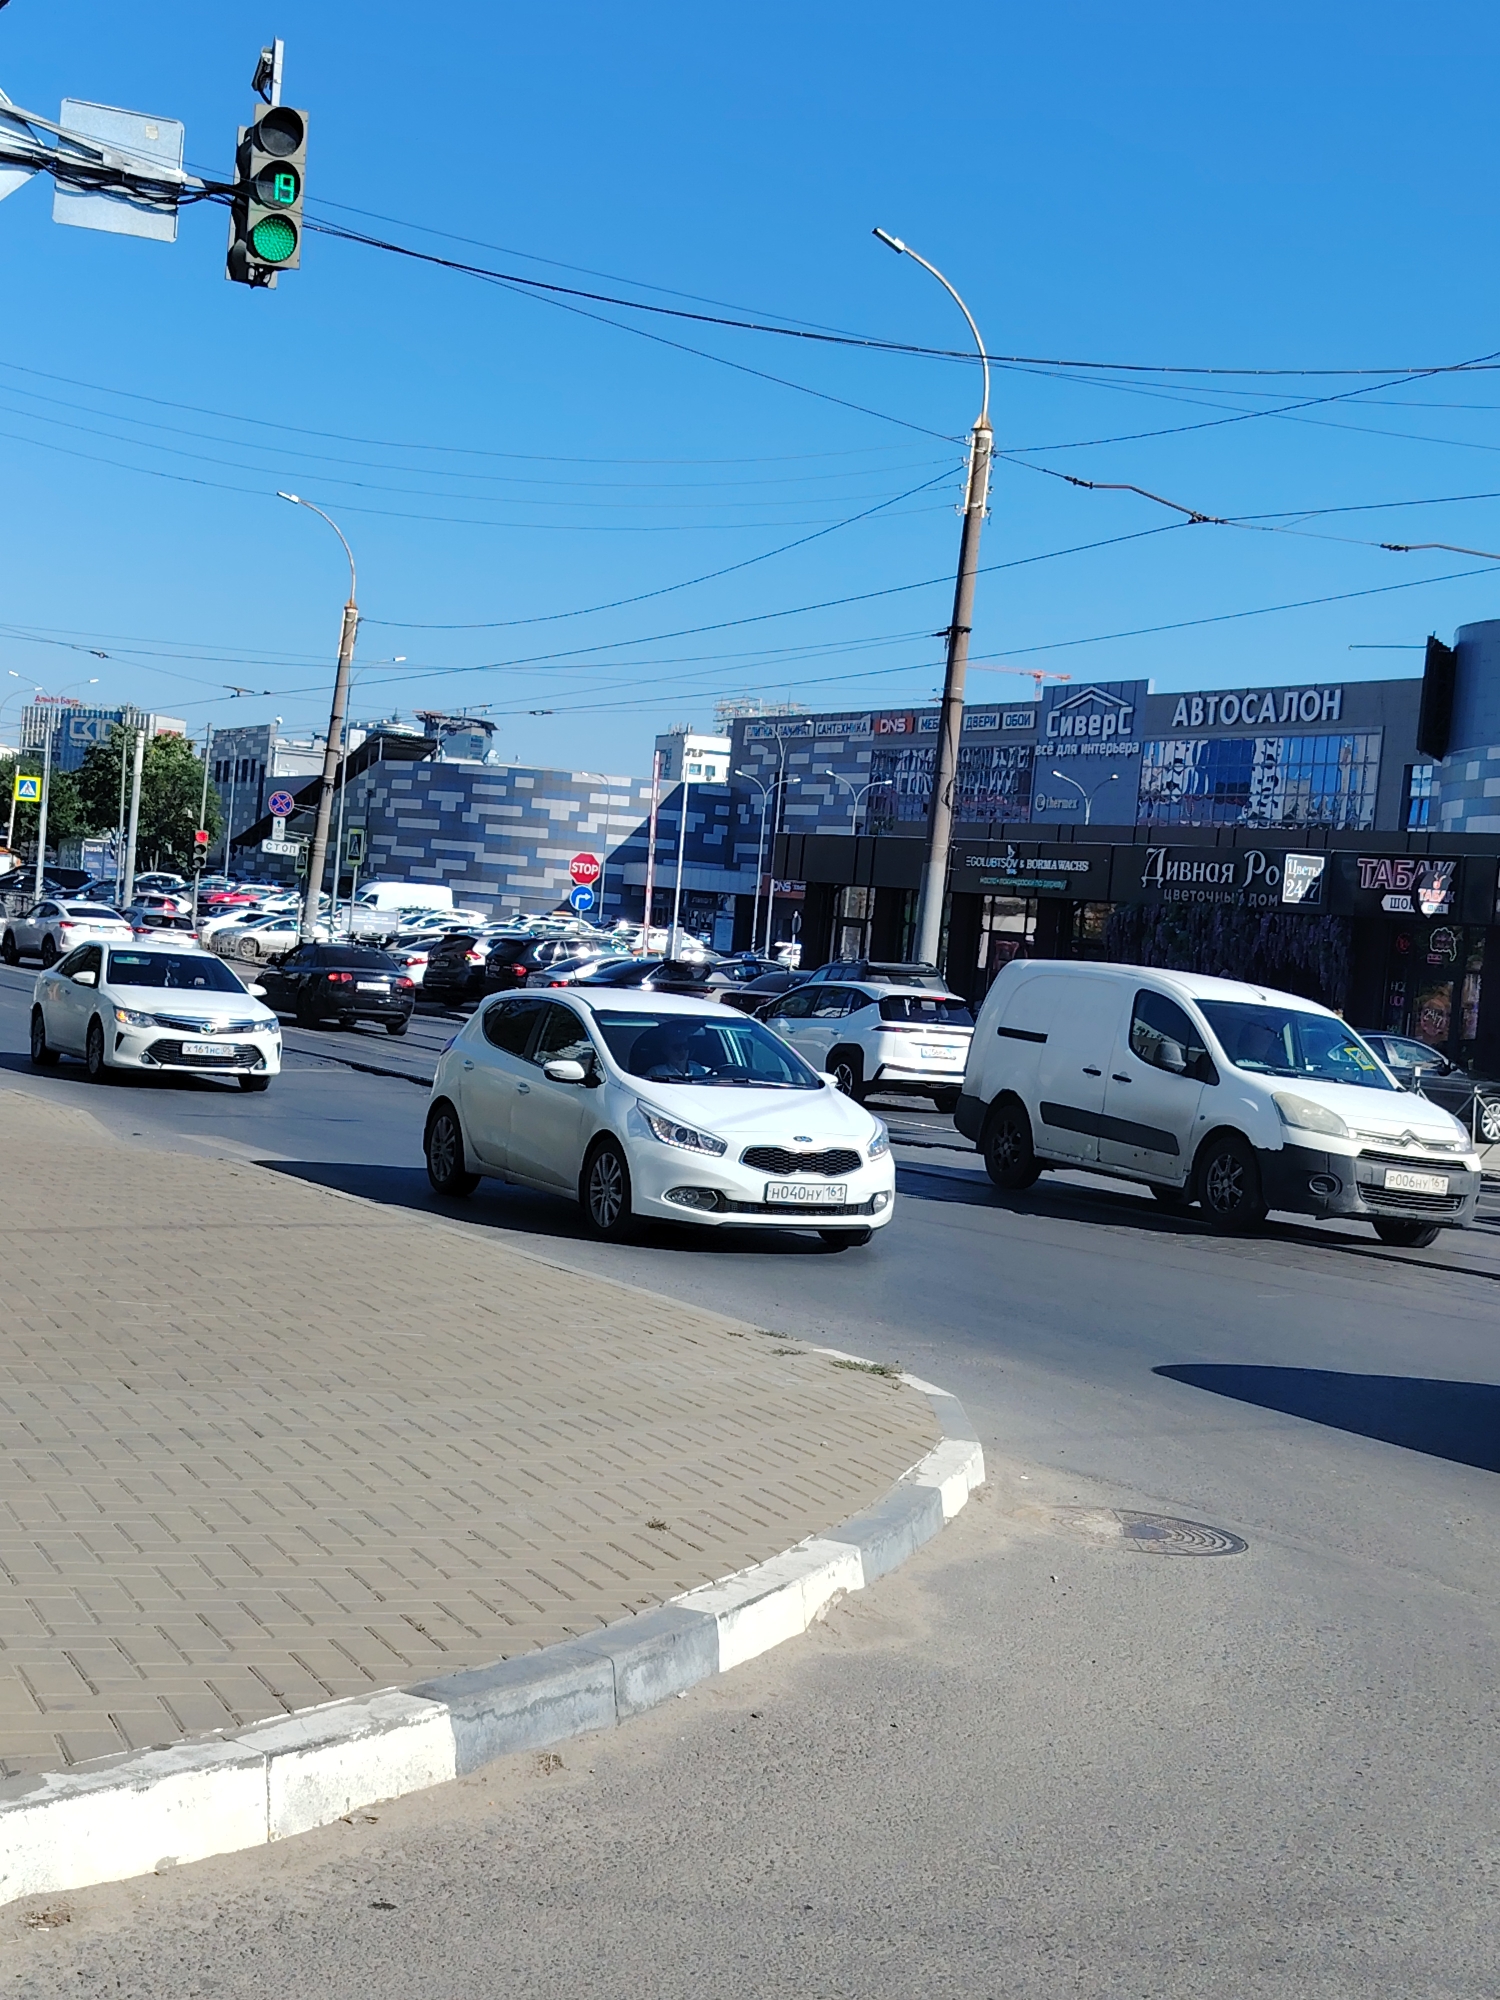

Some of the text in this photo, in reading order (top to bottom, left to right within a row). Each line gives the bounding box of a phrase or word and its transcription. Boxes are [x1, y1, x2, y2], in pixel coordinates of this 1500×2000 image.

[274, 173, 295, 204] 19
[1171, 689, 1342, 727] АВТОСАЛОН
[880, 718, 906, 733] DNS
[965, 715, 996, 729] ДВЕРИ
[1005, 713, 1031, 727] ОБОИ
[1046, 706, 1133, 741] СиверС
[817, 722, 867, 735] САНТЕХНИКА
[1035, 741, 1140, 757] всё для интерьера
[265, 842, 297, 854] СТОП
[571, 862, 599, 876] STOP
[1026, 859, 1058, 871] BORMA
[1058, 860, 1090, 872] WACHS
[1141, 848, 1236, 889] Дивная
[1287, 858, 1322, 878] Цветы
[1286, 878, 1320, 899] 24/7
[1248, 893, 1279, 908] дом
[1389, 1174, 1428, 1189] Р006НУ
[771, 1186, 843, 1200] Н040НУ 161
